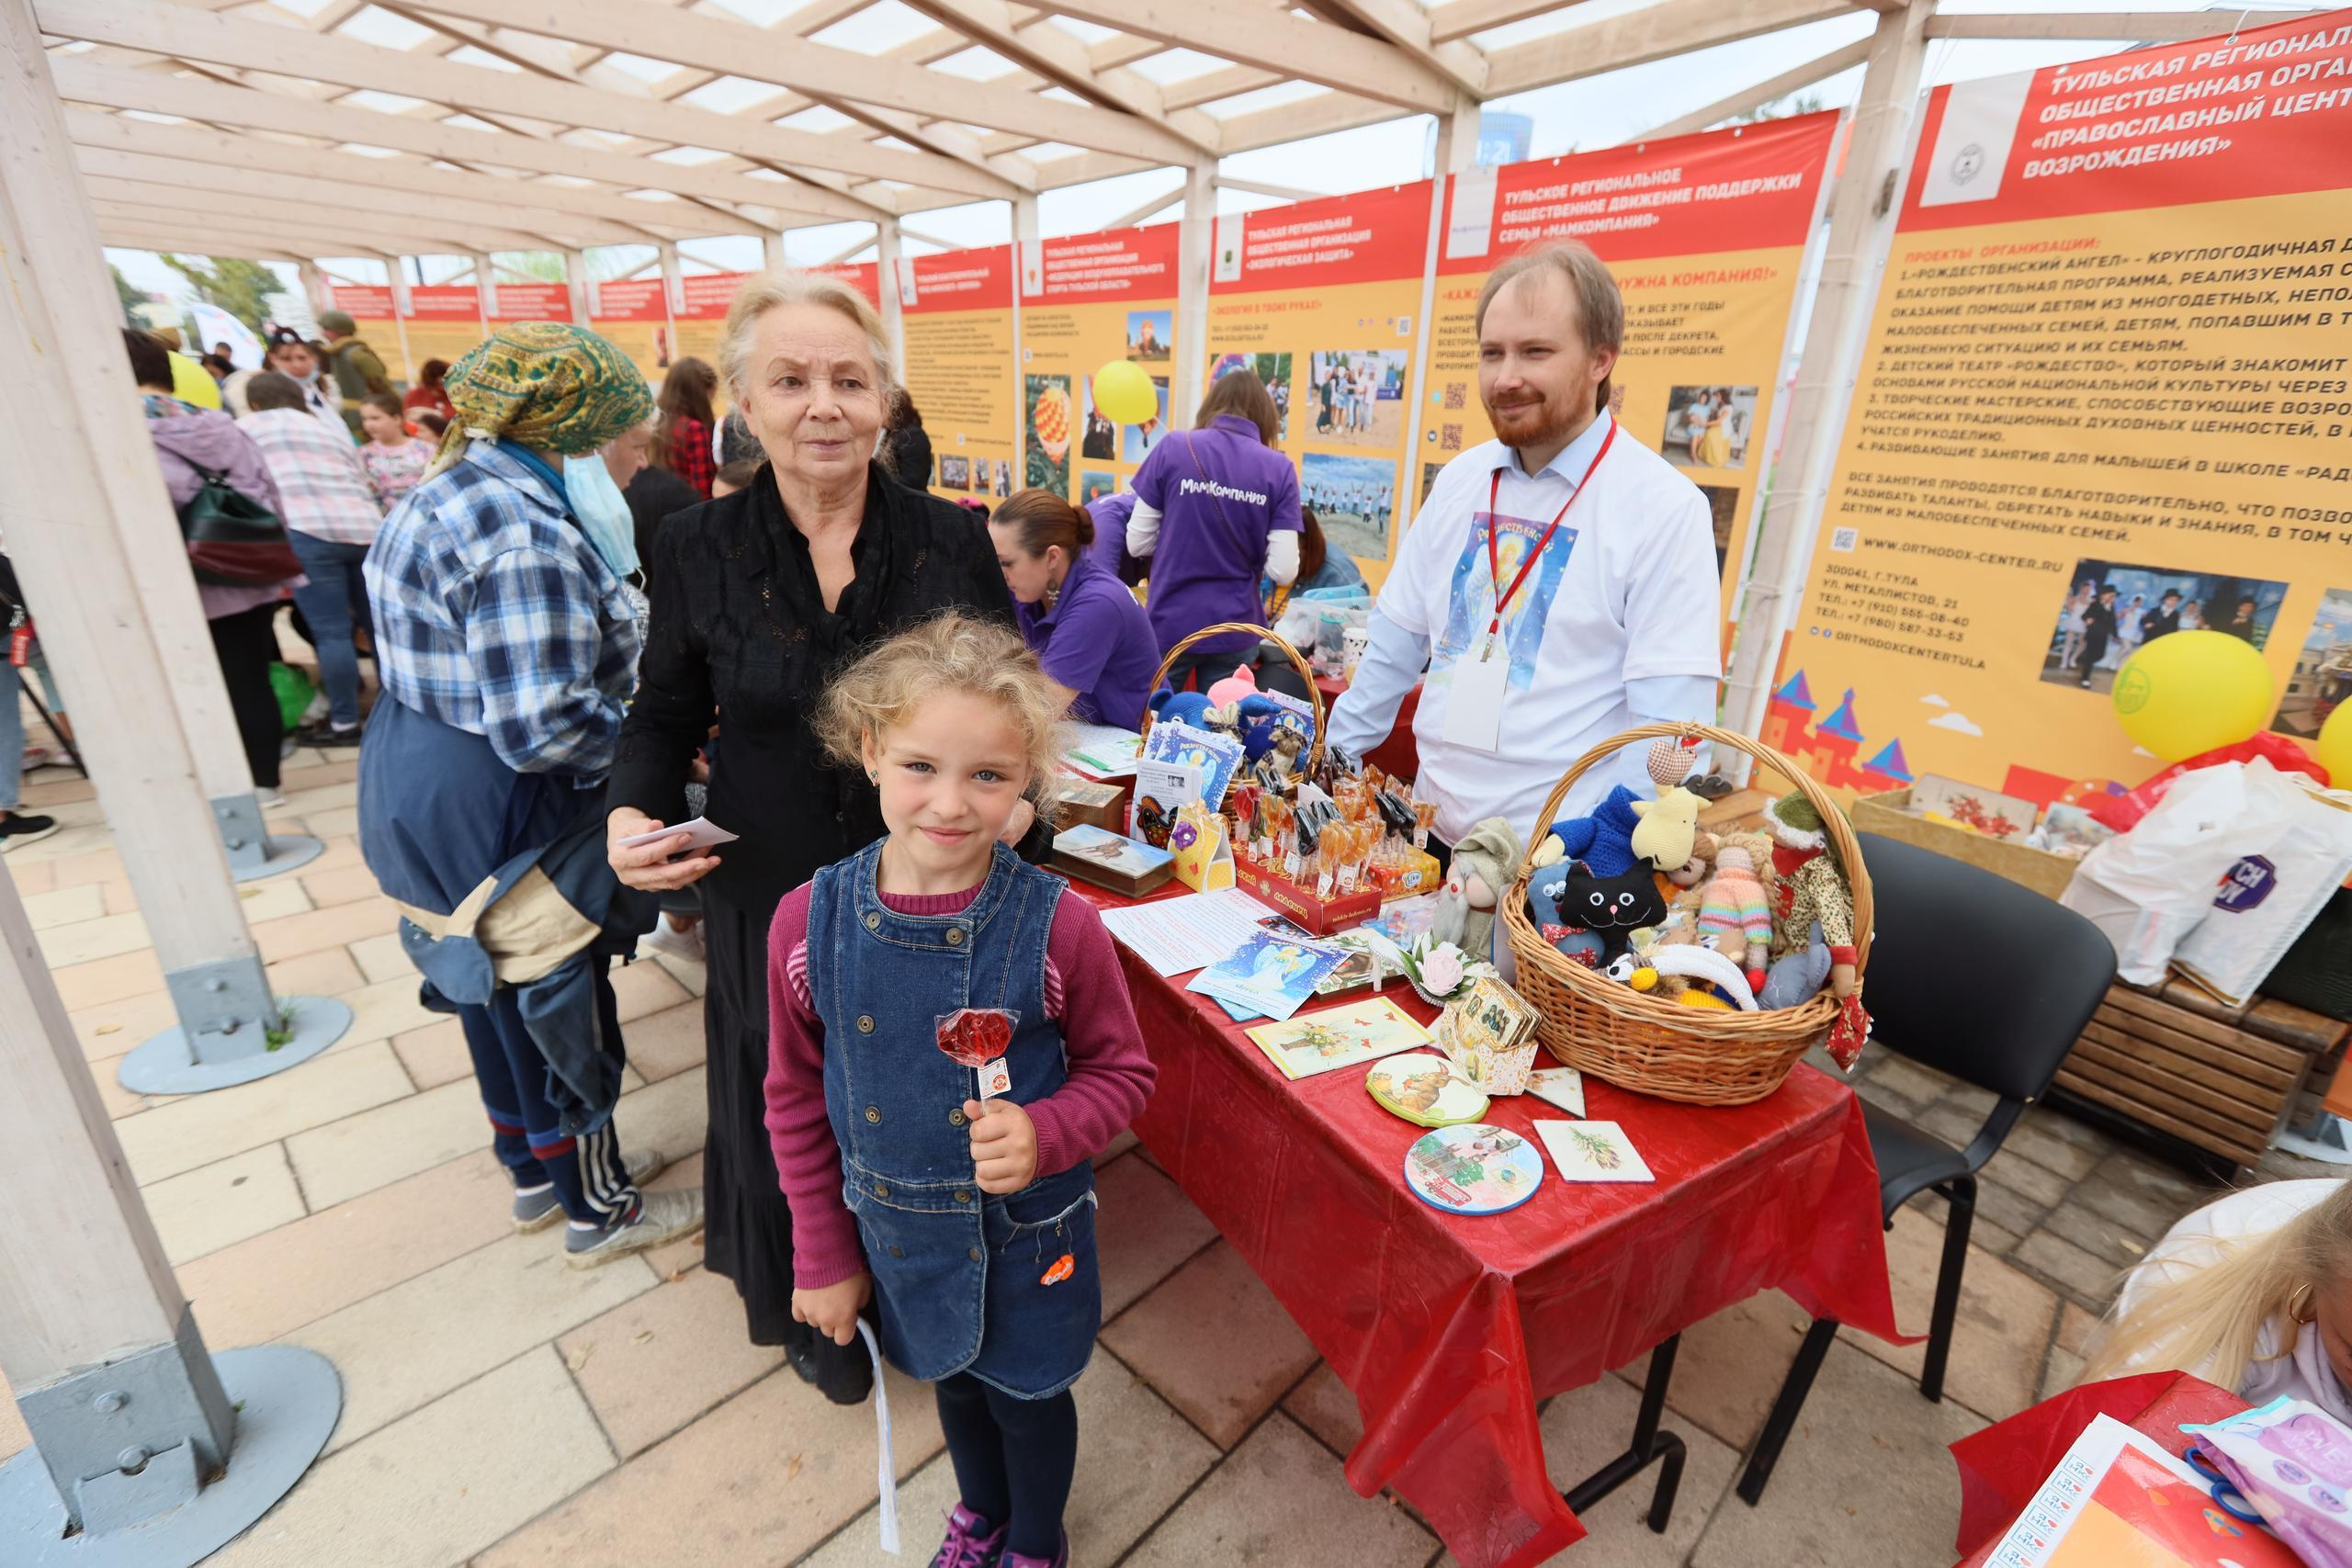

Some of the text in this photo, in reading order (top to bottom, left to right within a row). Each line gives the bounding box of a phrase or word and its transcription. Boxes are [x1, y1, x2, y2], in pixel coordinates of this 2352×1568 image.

[2051, 56, 2187, 96] ТУЛЬСКАЯ
[2039, 70, 2265, 123] ОБЩЕСТВЕННАЯ
[2031, 86, 2352, 151] «ПРАВОСЛАВНЫЙ ЦЕНТ
[2021, 136, 2233, 180] ВОЗРОЖДЕНИЯ»
[1501, 173, 1804, 225] ОБЩЕСТВЕННОЕ ДВИЖЕНИЕ ПОДДЕРЖКИ
[1504, 167, 1682, 205] ТУЛЬСКОЕ РЕГИОНАЛЬНОЕ
[1498, 226, 1541, 243] СЕМЬИ
[1544, 212, 1660, 238] «МАМКОМПАНИЯ»
[1904, 237, 2101, 263] ПРОЕКТЫ ОРГАНИЗАЦИИ:
[2064, 254, 2129, 269] АНГЕЛ»
[2146, 239, 2335, 265] КРУГЛОГОДИЧНАЯ
[1895, 279, 2058, 299] БЛАГОТВОРИТЕЛЬНАЯ
[2062, 274, 2173, 290] ПРОГРАММА,
[2179, 263, 2335, 285] РЕАЛИЗУЕМАЯ
[1693, 300, 1724, 312] ГОДЫ
[1891, 288, 2352, 318] ОКАЗАНИЕ ПОМОЩИ ДЕТЯМ ИЗ МНОГОДЕТНЫХ, НЕПО
[1886, 321, 2044, 336] МАЛООБЕСПЕЧЕННЫХ
[2047, 318, 2109, 333] СЕМЕЙ,
[2114, 317, 2181, 333] ДЕТЯМ,
[2188, 312, 2312, 329] ПОПАВШИМ
[2316, 312, 2333, 326] В
[1663, 345, 1725, 355] ГОРОДСКИЕ
[1882, 338, 2188, 355] ЖИЗНЕННУЮ СИТУАЦИЮ И ИХ СЕМЬЯМ.
[1890, 358, 1954, 372] ДЕТСКИЙ
[1959, 360, 2004, 372] ТЕАТР
[2134, 355, 2225, 372] КОТОРЫЙ
[2230, 357, 2347, 372] ЗНАКОМИТ
[1872, 375, 2347, 394] ОСНОВАМИ РУССКОЙ НАЦИОНАЛЬНОЙ КУЛЬТУРЫ ЧЕРЕЗ
[1883, 393, 1971, 406] ТВОРЧЕСКИЕ
[1976, 396, 2082, 410] МАСТЕРСКИЕ,
[2086, 397, 2275, 414] СПОСОБСТВУЮЩИЕ
[2280, 401, 2352, 415] ВОЗРО
[1860, 425, 2006, 442] УЧАТСЯ РУКОДЕЛИЮ.
[1864, 409, 2342, 438] РОССИЙСКИХ ТРАДИЦИОННЫХ ДУХОВНЫХ ЦЕННОСТЕЙ, В
[1870, 442, 1976, 458] РАЗВИВАЮЩИЕ
[1981, 448, 2051, 463] ЗАНЯТИЯ
[2053, 452, 2089, 465] ДЛЯ
[2093, 454, 2189, 471] МАЛЫШЕЙ
[2195, 459, 2209, 472] В
[2214, 460, 2290, 477] ШКОЛЕ
[2294, 465, 2352, 482] «РАД
[1849, 471, 1872, 483] ВСЕ
[1877, 473, 1936, 488] ЗАНЯТИЯ
[1939, 478, 2037, 497] ПРОВОДЯТСЯ
[2041, 487, 2230, 514] БЛАГОТВОРИТЕЛЬНО,
[2237, 502, 2275, 517] ЧТО
[1839, 502, 2132, 543] ДЕТЯМ ИЗ МАЛООБЕСПЕЧЕННЫХ СЕМЕЙ.
[1844, 487, 1917, 502] РАЗВИВАТЬ
[1921, 493, 1991, 511] ТАЛАНТЫ,
[1996, 501, 2075, 518] ОБРЕТАТЬ
[2079, 510, 2154, 525] НАВЫКИ
[2159, 516, 2171, 527] И
[2177, 517, 2260, 537] ЗНАНИЯ,
[2267, 525, 2282, 538] В
[2289, 527, 2332, 543] ТОМ
[1863, 537, 2064, 572] WWW.ORTHODOX-CENTER.RU
[1874, 571, 1919, 587] Г.ТУЛА
[1845, 582, 1939, 607] МЕТАЛЛИСТОВ,
[1944, 599, 1958, 610] 21
[1851, 599, 1865, 609] +7
[1868, 601, 1898, 615] (910)
[1847, 613, 1861, 623] +7
[1836, 631, 1985, 670] ORTHODOXCENTERTULA
